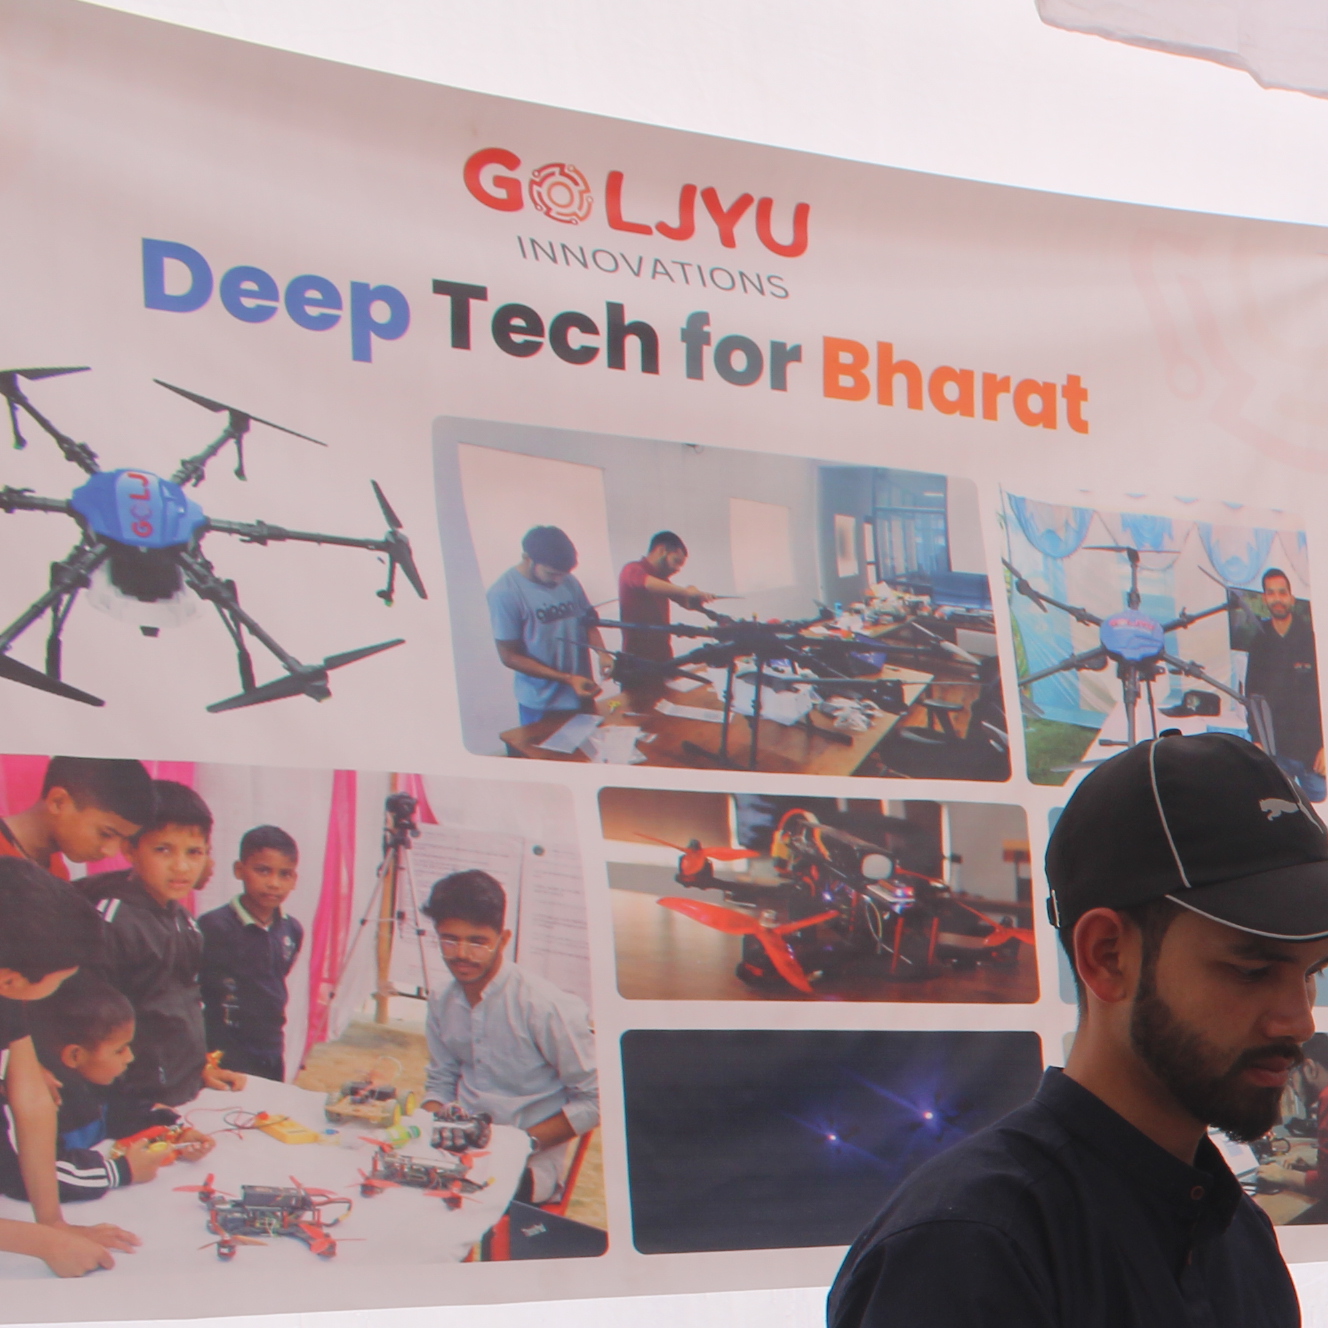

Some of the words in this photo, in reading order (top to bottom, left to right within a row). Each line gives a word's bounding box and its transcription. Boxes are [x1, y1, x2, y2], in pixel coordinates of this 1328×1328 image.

[462, 147, 810, 259] GOLJYU
[516, 234, 790, 300] INNOVATIONS
[140, 237, 411, 363] Deep
[431, 277, 660, 376] Tech
[680, 310, 803, 392] for
[821, 335, 1090, 436] Bharat
